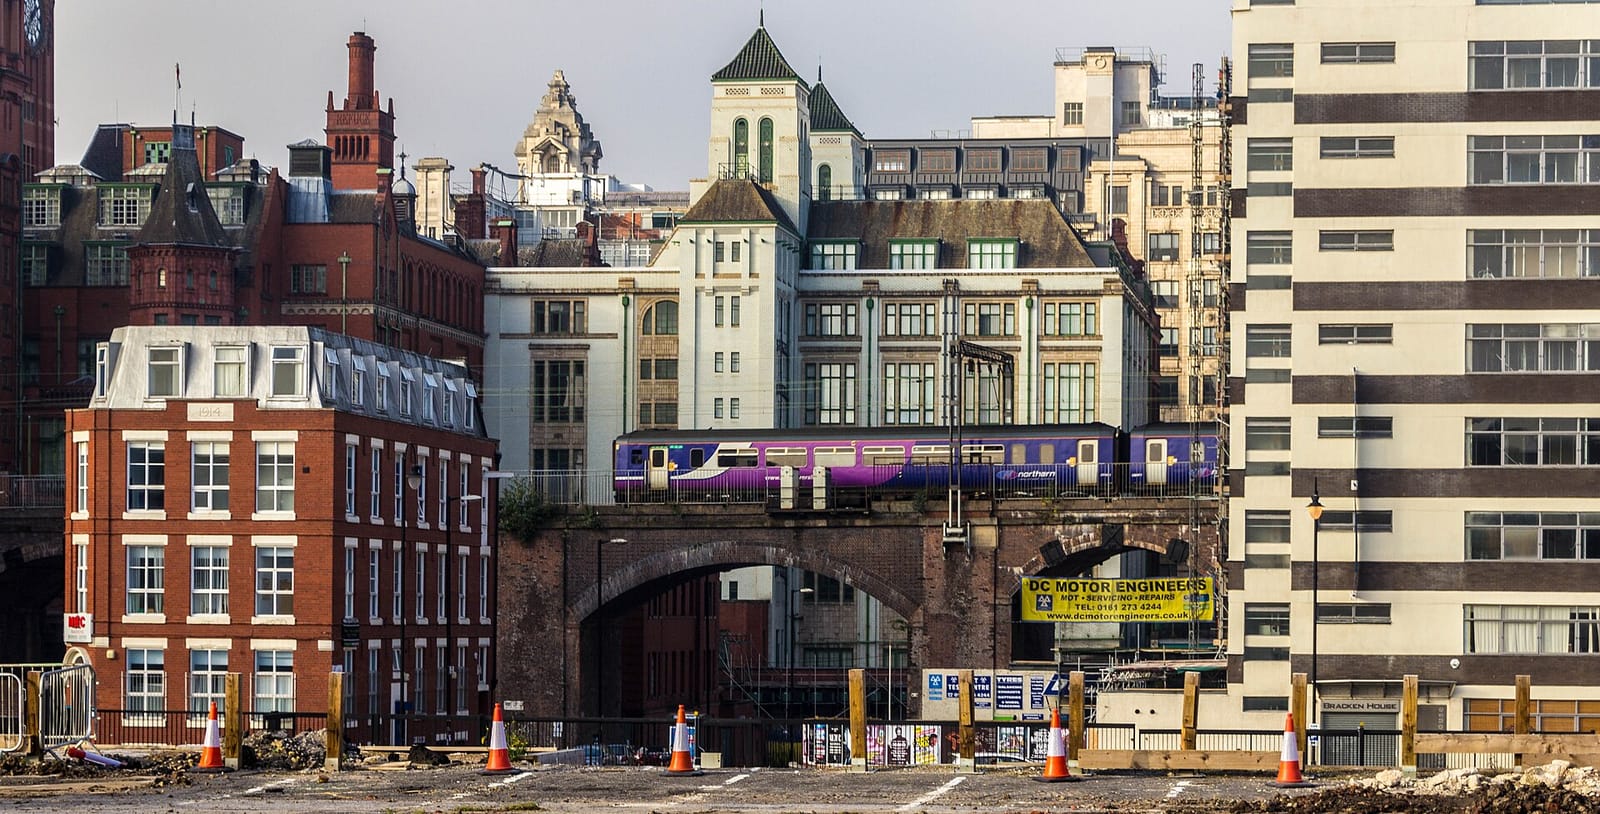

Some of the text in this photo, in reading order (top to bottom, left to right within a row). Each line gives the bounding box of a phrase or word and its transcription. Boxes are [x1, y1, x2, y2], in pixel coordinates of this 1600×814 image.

[1017, 470, 1056, 478] northern
[1029, 580, 1207, 593] DC MOTOR ENGINEERS
[1086, 594, 1133, 602] SERVICING
[1075, 603, 1162, 611] TEL: 0161 273 4244
[1046, 611, 1189, 621] www.dcmotorengineers.co.uk
